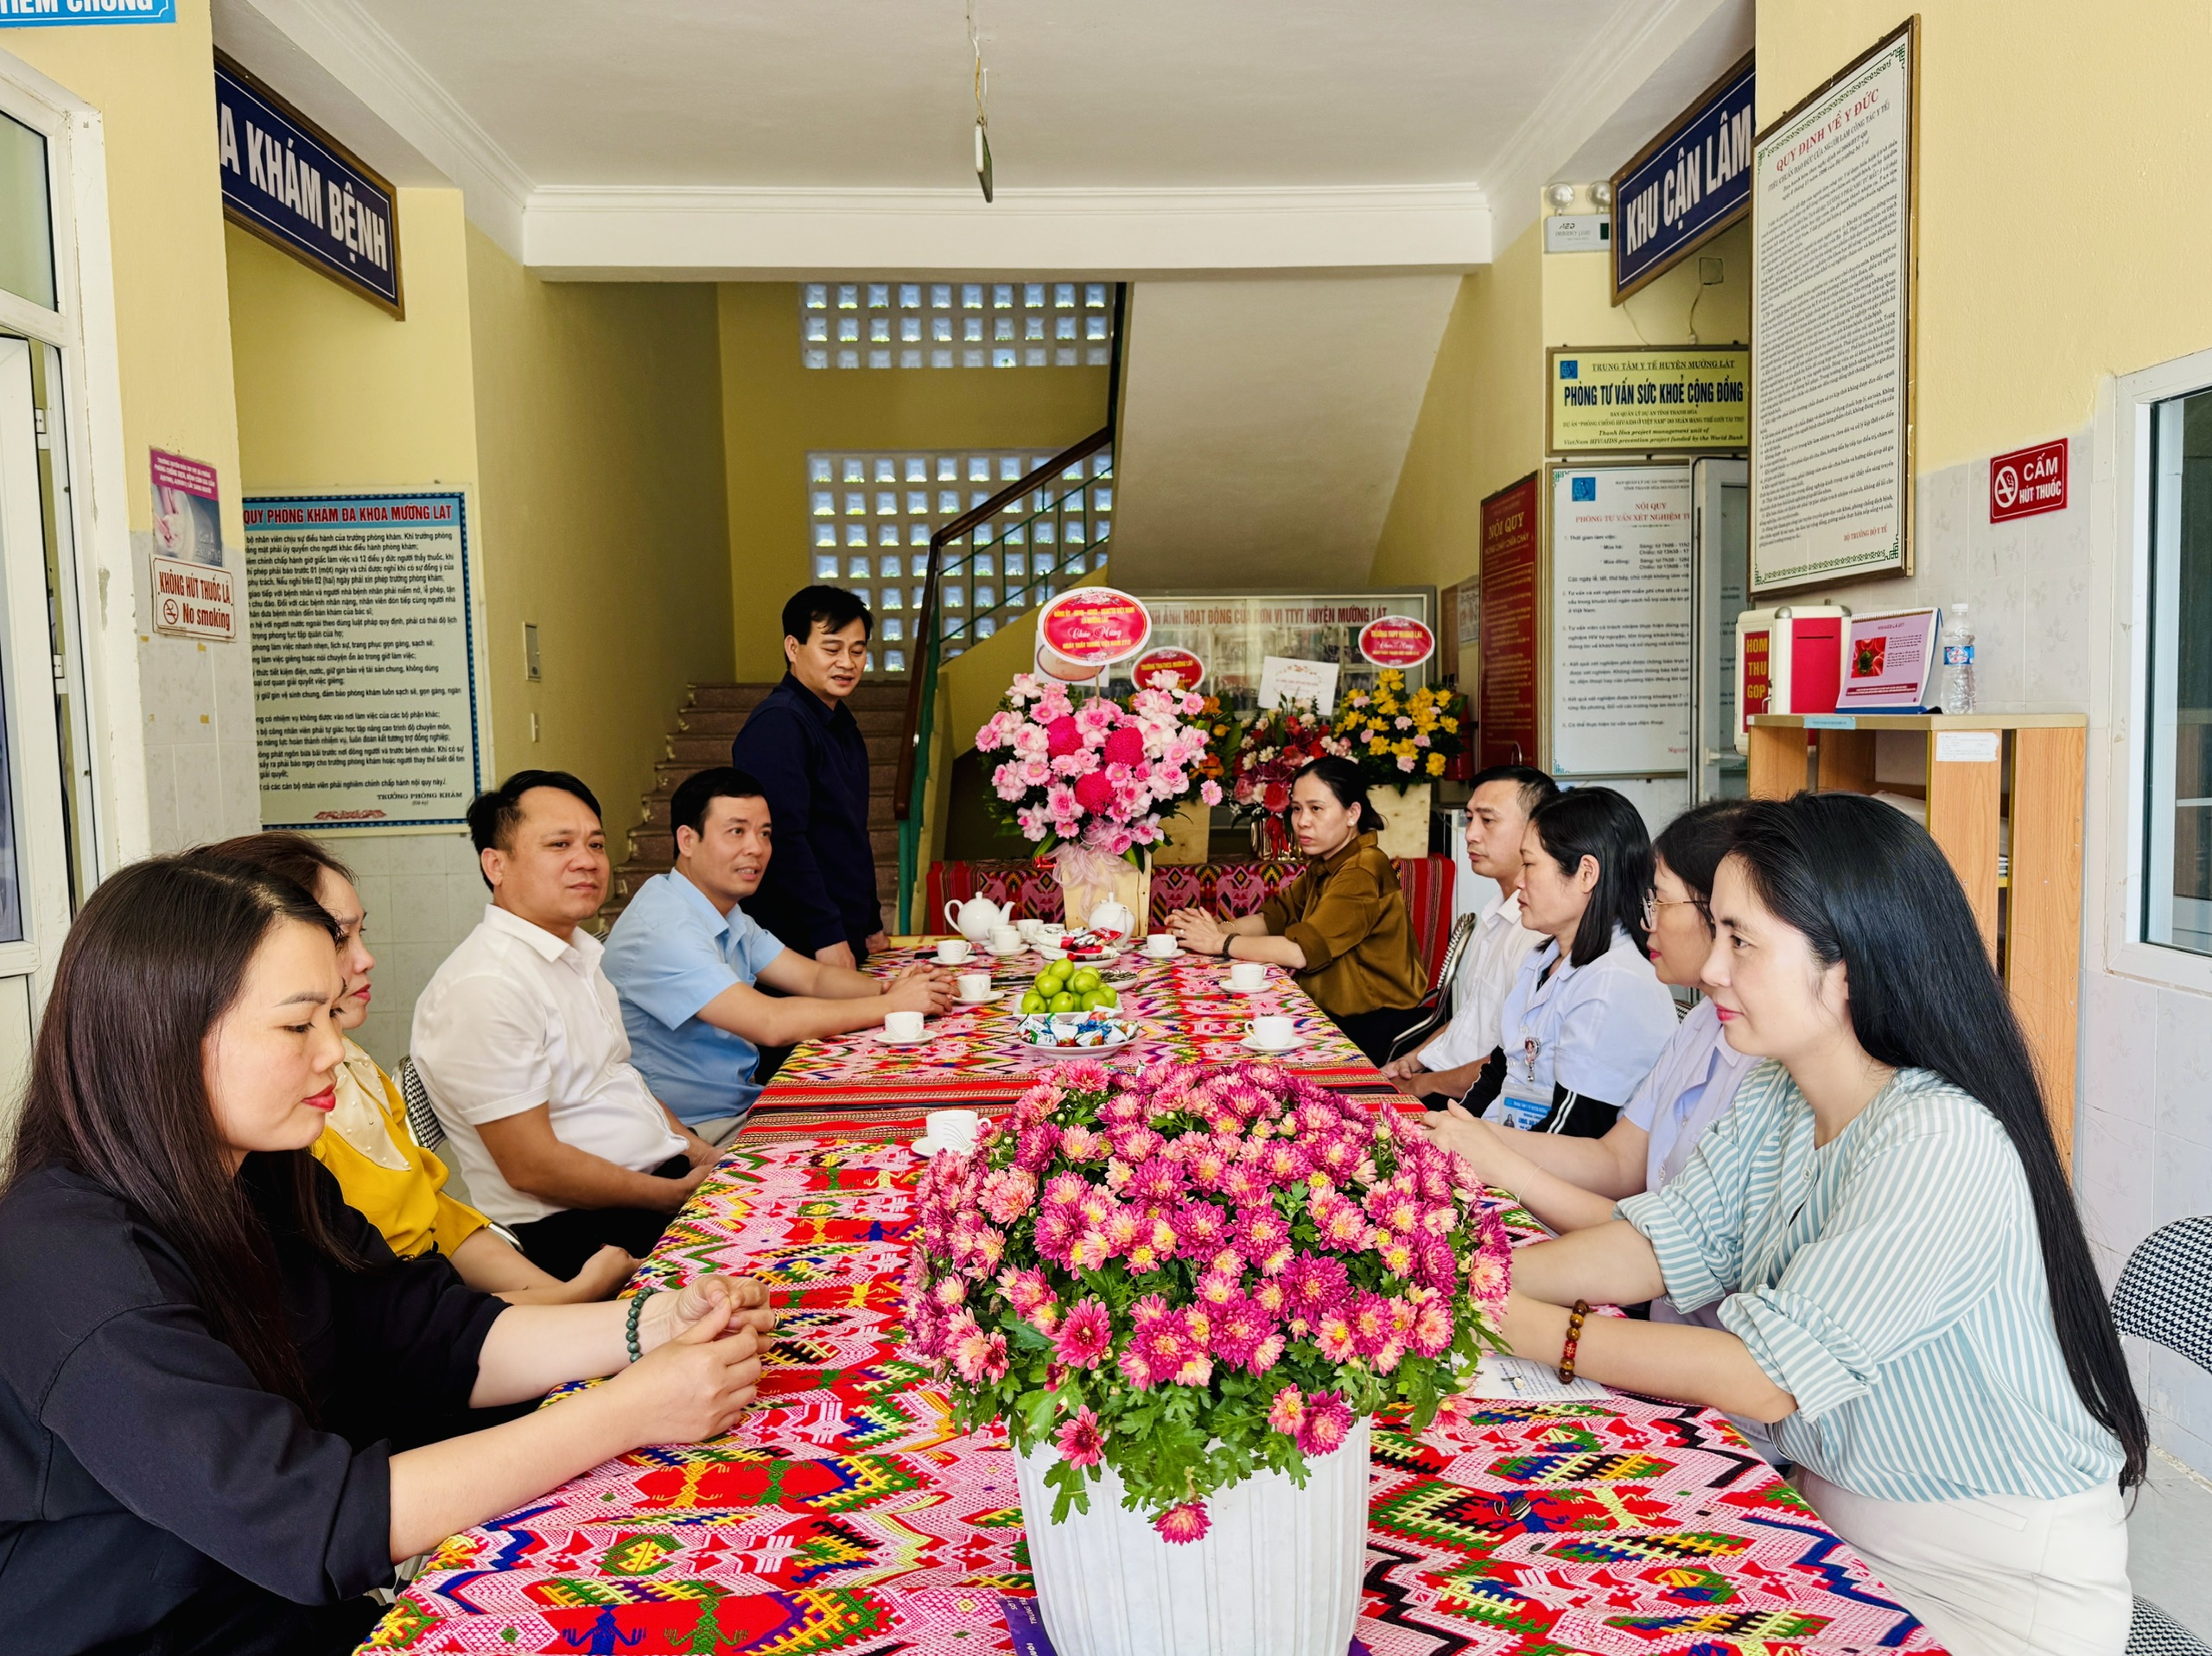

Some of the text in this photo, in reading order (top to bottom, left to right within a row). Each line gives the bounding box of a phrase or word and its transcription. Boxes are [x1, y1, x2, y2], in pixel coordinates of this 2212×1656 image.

[1777, 88, 1878, 171] QUY ĐỊNH VỀ Y ĐỨC
[1627, 181, 1658, 256] KHU
[1663, 147, 1700, 231] CẬN
[1707, 104, 1751, 195] LÂM
[245, 119, 322, 231] KHÁM
[328, 181, 388, 272] BỆNH
[1621, 360, 1637, 371] TÂM
[1564, 381, 1597, 406] PHÒNG
[1600, 383, 1613, 405] TƯ
[1615, 378, 1634, 404] VẤN
[1637, 378, 1656, 404] SỨC
[1688, 378, 1713, 408] CỘNG
[2024, 453, 2057, 481] CẤM
[2019, 476, 2061, 504] HÚT THUỐC
[244, 510, 264, 524] QUY
[267, 505, 303, 523] PHÒNG
[307, 505, 338, 523] KHÁM
[342, 508, 356, 522] ĐA
[359, 507, 388, 521] KHOA
[391, 503, 430, 520] MƯỜNG
[1635, 502, 1649, 511] NỘI
[1488, 511, 1524, 540] NỘI QUY
[159, 568, 230, 604] KHÔNG HÚT THUỐC LÁ
[182, 603, 230, 631] No smoking
[1184, 609, 1205, 627] HOẠT
[1208, 606, 1231, 627] ĐỘNG
[1285, 608, 1304, 623] TTYT
[1306, 605, 1334, 625] HUYỆN
[1338, 605, 1369, 622] MƯỜNG
[1746, 638, 1768, 653] HOM
[1748, 661, 1767, 676] THU
[1747, 684, 1765, 699] GOP
[1024, 1606, 1038, 1624] TRUNG
